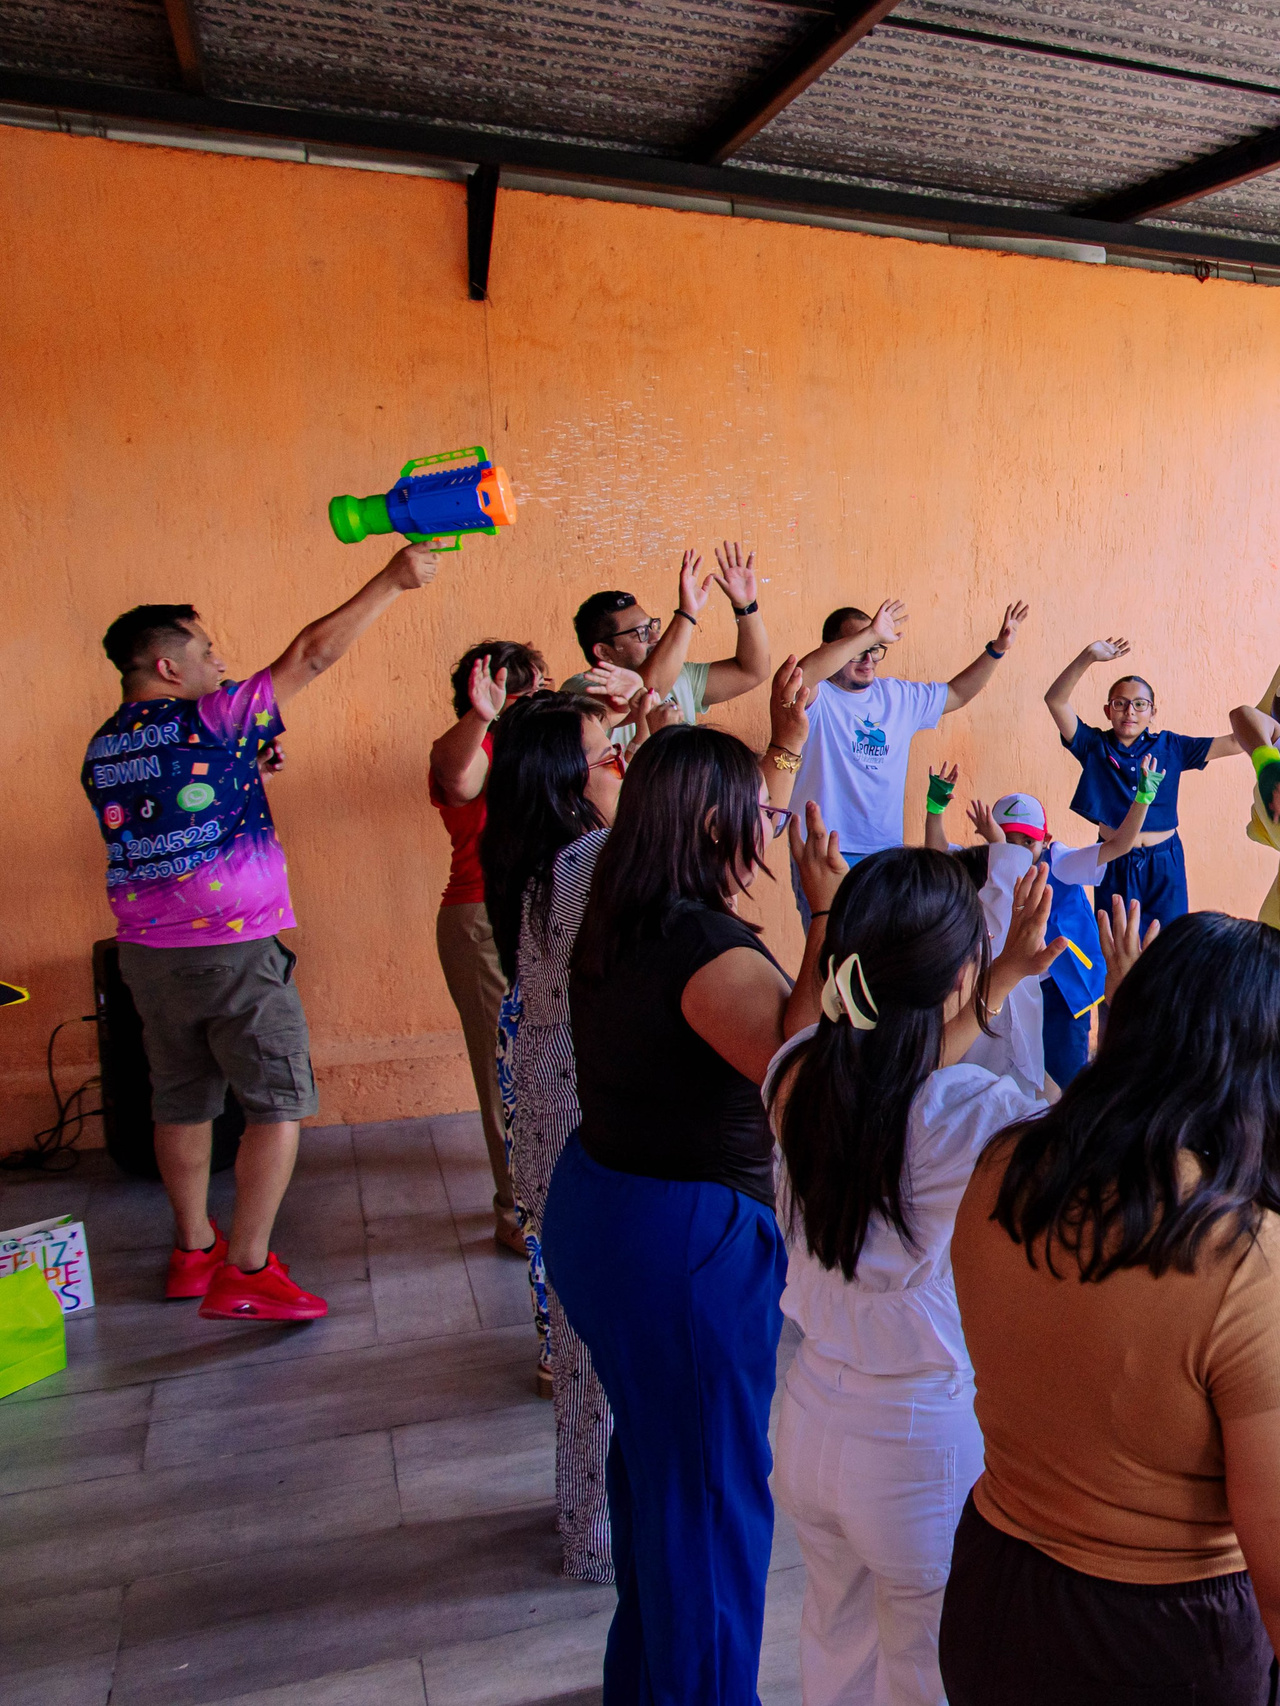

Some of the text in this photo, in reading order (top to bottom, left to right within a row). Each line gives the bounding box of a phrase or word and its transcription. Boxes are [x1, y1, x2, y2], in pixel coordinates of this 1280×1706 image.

[852, 741, 890, 756] VAPOREON
[93, 755, 161, 789] EDWIN
[126, 820, 220, 860] 204523
